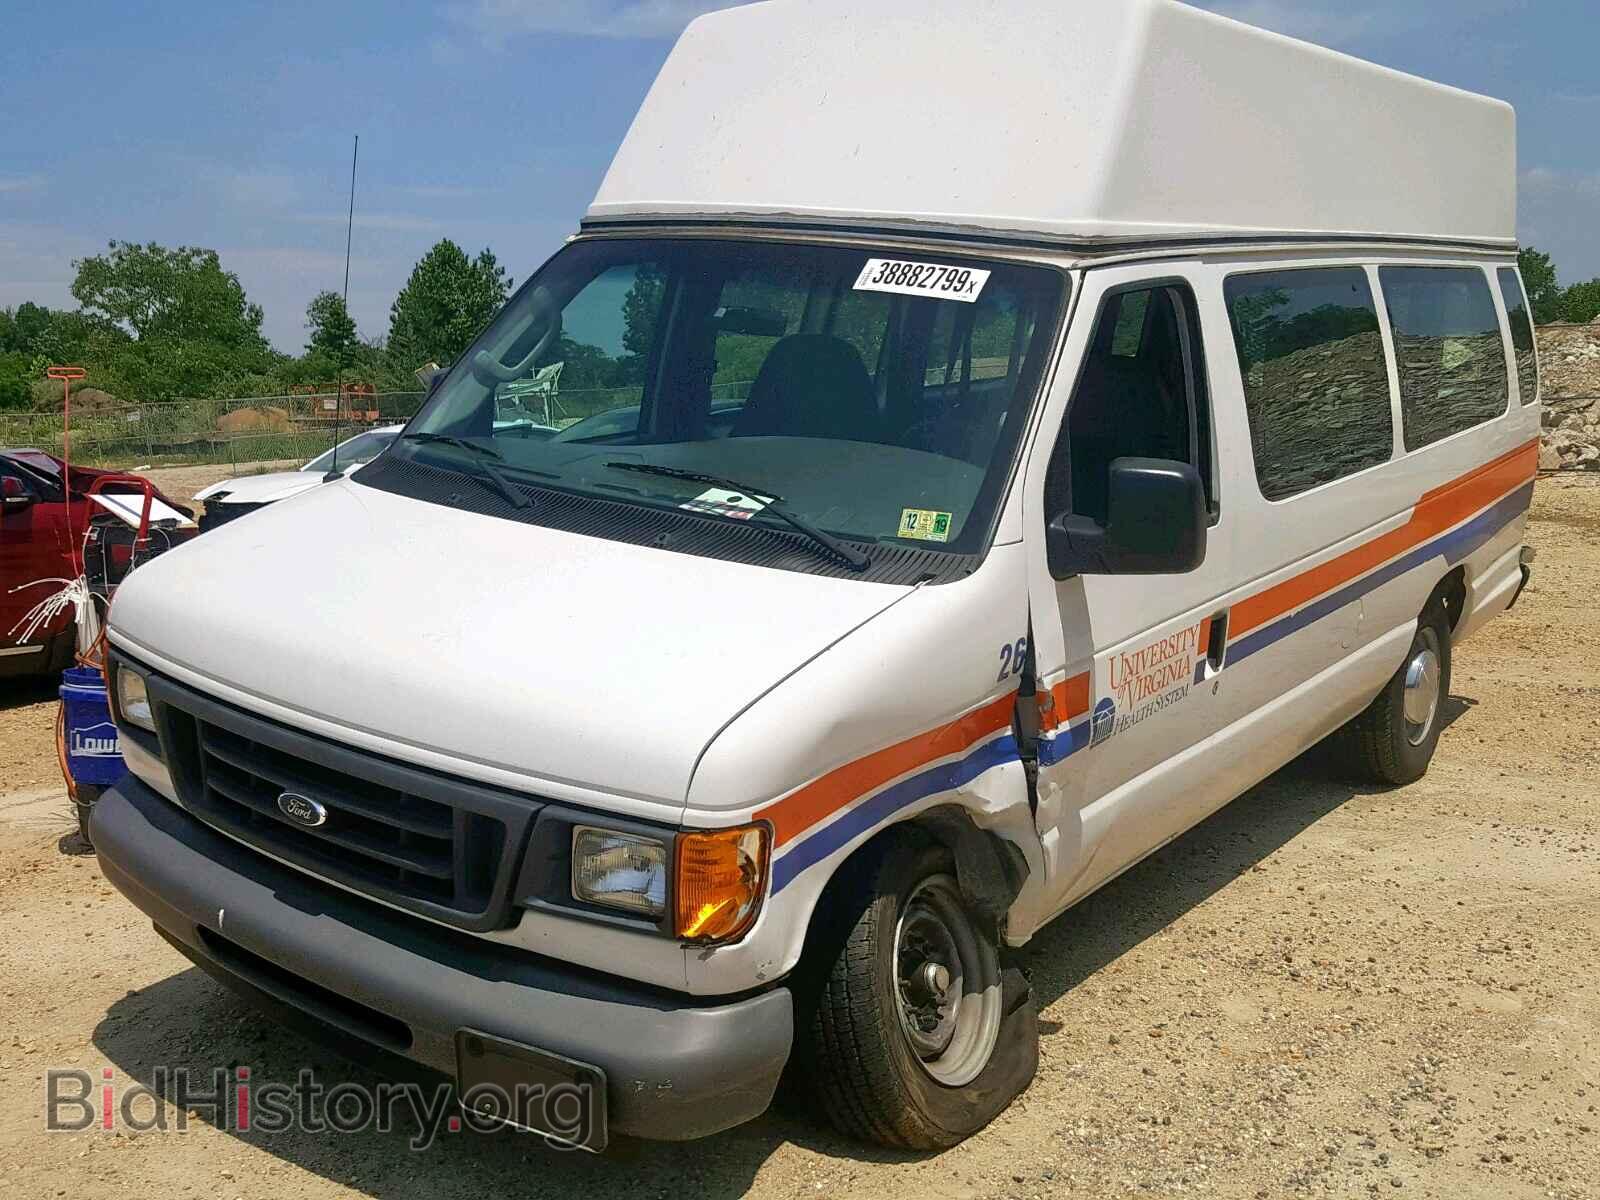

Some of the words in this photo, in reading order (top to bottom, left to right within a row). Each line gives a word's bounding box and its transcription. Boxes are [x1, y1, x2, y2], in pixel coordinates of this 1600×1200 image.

[907, 513, 918, 530] 12
[935, 517, 948, 533] 19
[997, 637, 1026, 682] 26
[1108, 624, 1200, 690] UNIVERSITY
[1125, 655, 1191, 712] VIRGINIA
[1112, 701, 1154, 737] HEALTH
[1153, 683, 1190, 713] SYSTEM
[287, 799, 312, 819] Ford
